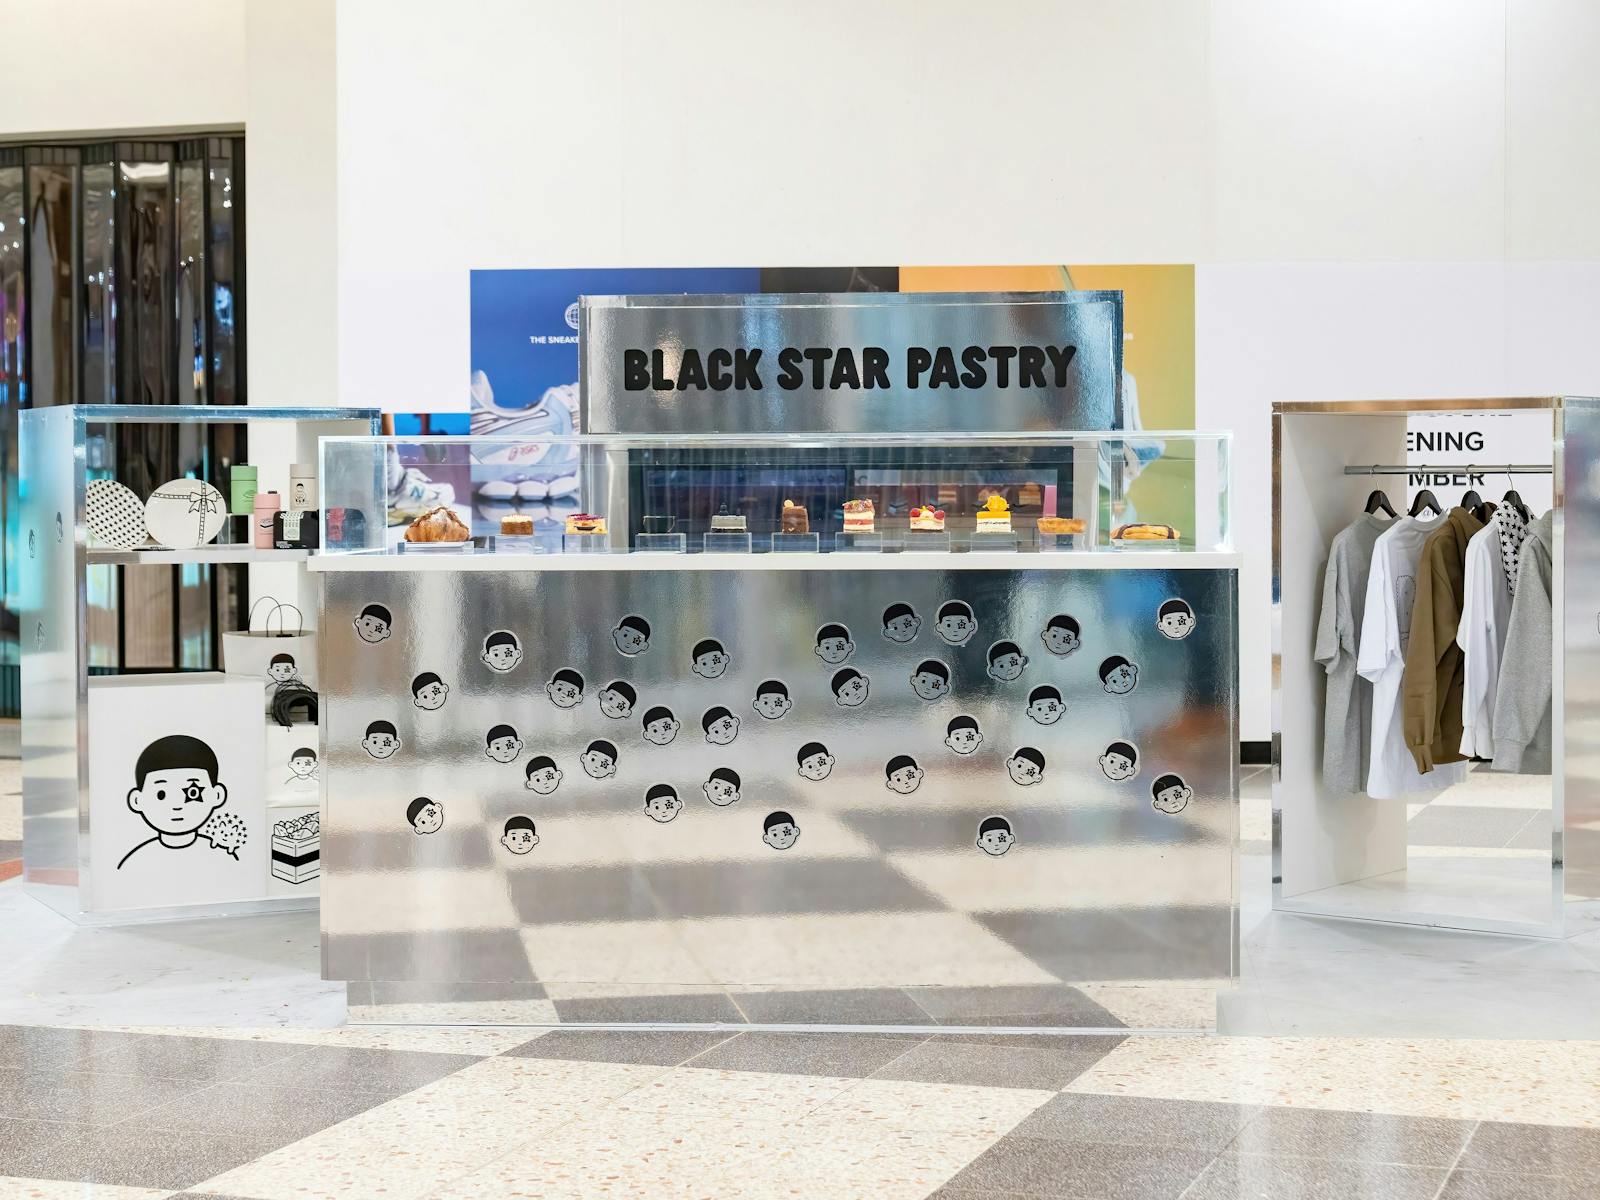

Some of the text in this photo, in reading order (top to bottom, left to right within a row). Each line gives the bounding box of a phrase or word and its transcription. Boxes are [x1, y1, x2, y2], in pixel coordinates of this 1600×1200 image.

[530, 335, 546, 344] THE
[624, 345, 1077, 391] BLACK STAR PASTRY
